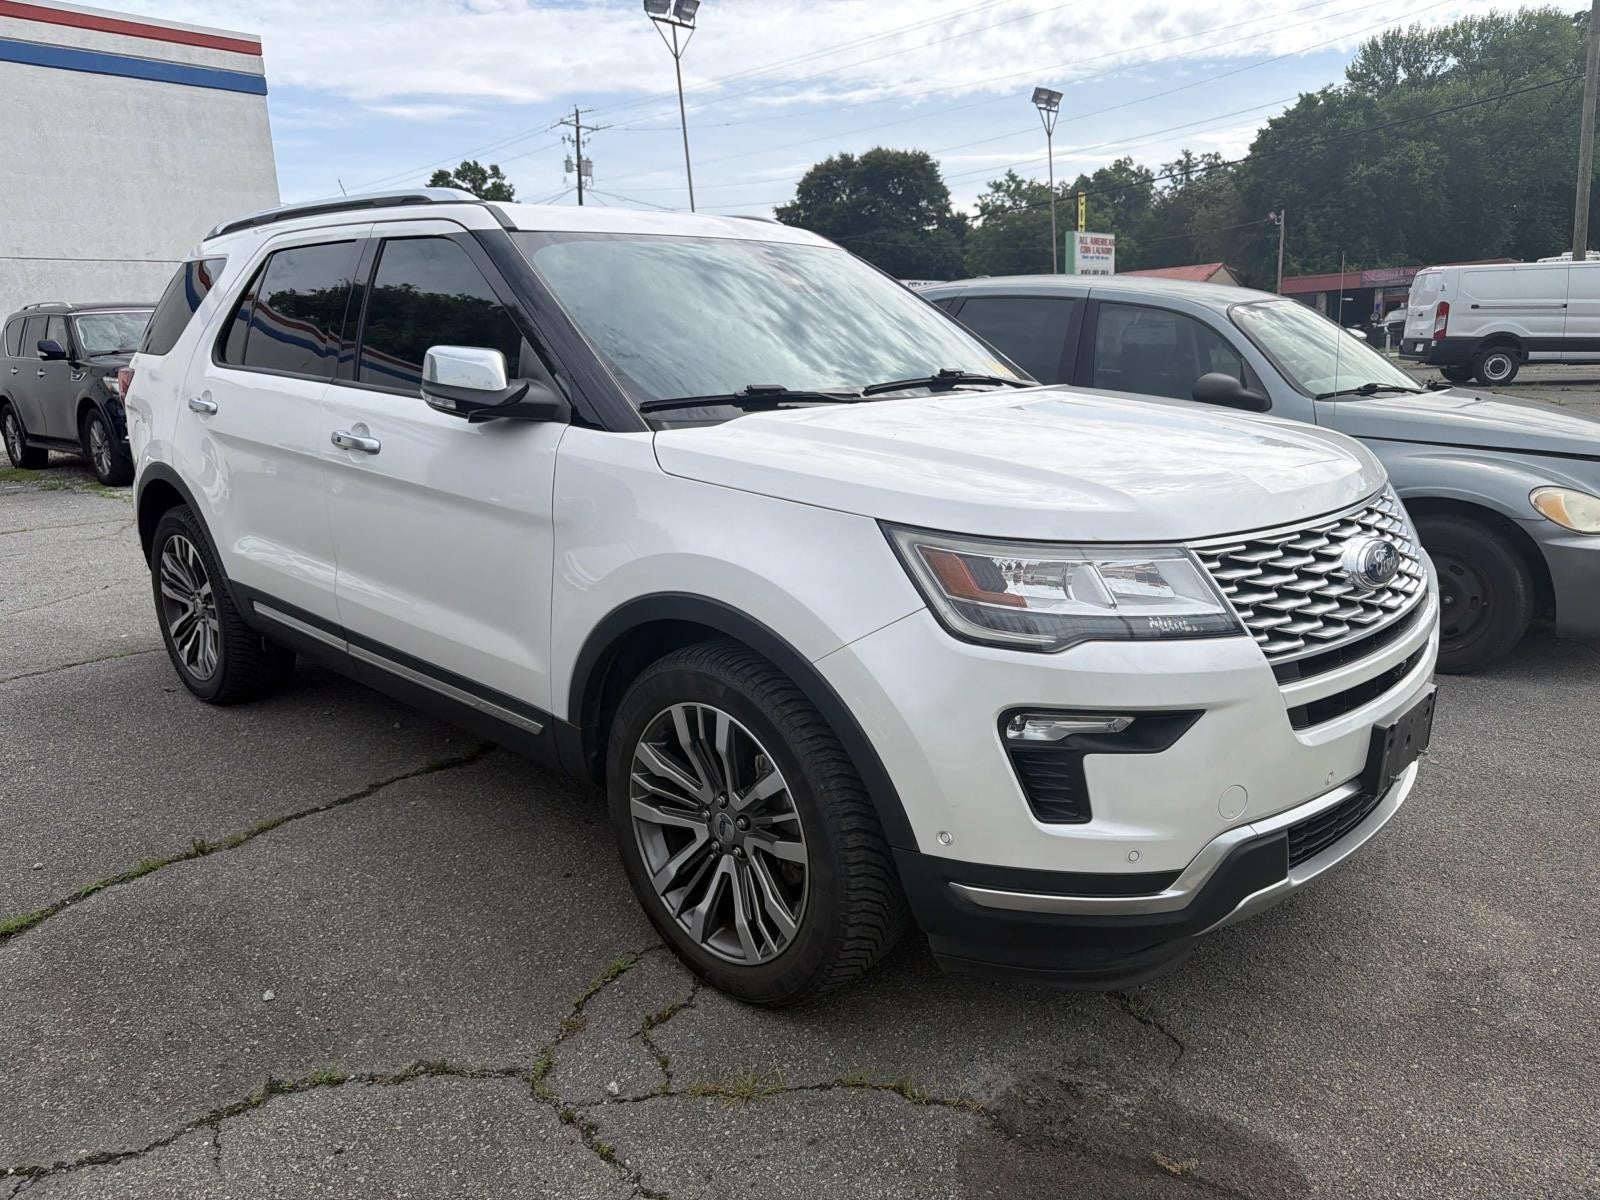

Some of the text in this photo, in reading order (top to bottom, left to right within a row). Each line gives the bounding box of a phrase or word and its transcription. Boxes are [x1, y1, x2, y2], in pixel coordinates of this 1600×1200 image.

[1079, 236, 1116, 247] ALL AMERICAN
[1080, 245, 1113, 255] COIN LAUNDRY
[1374, 547, 1397, 576] Ford
